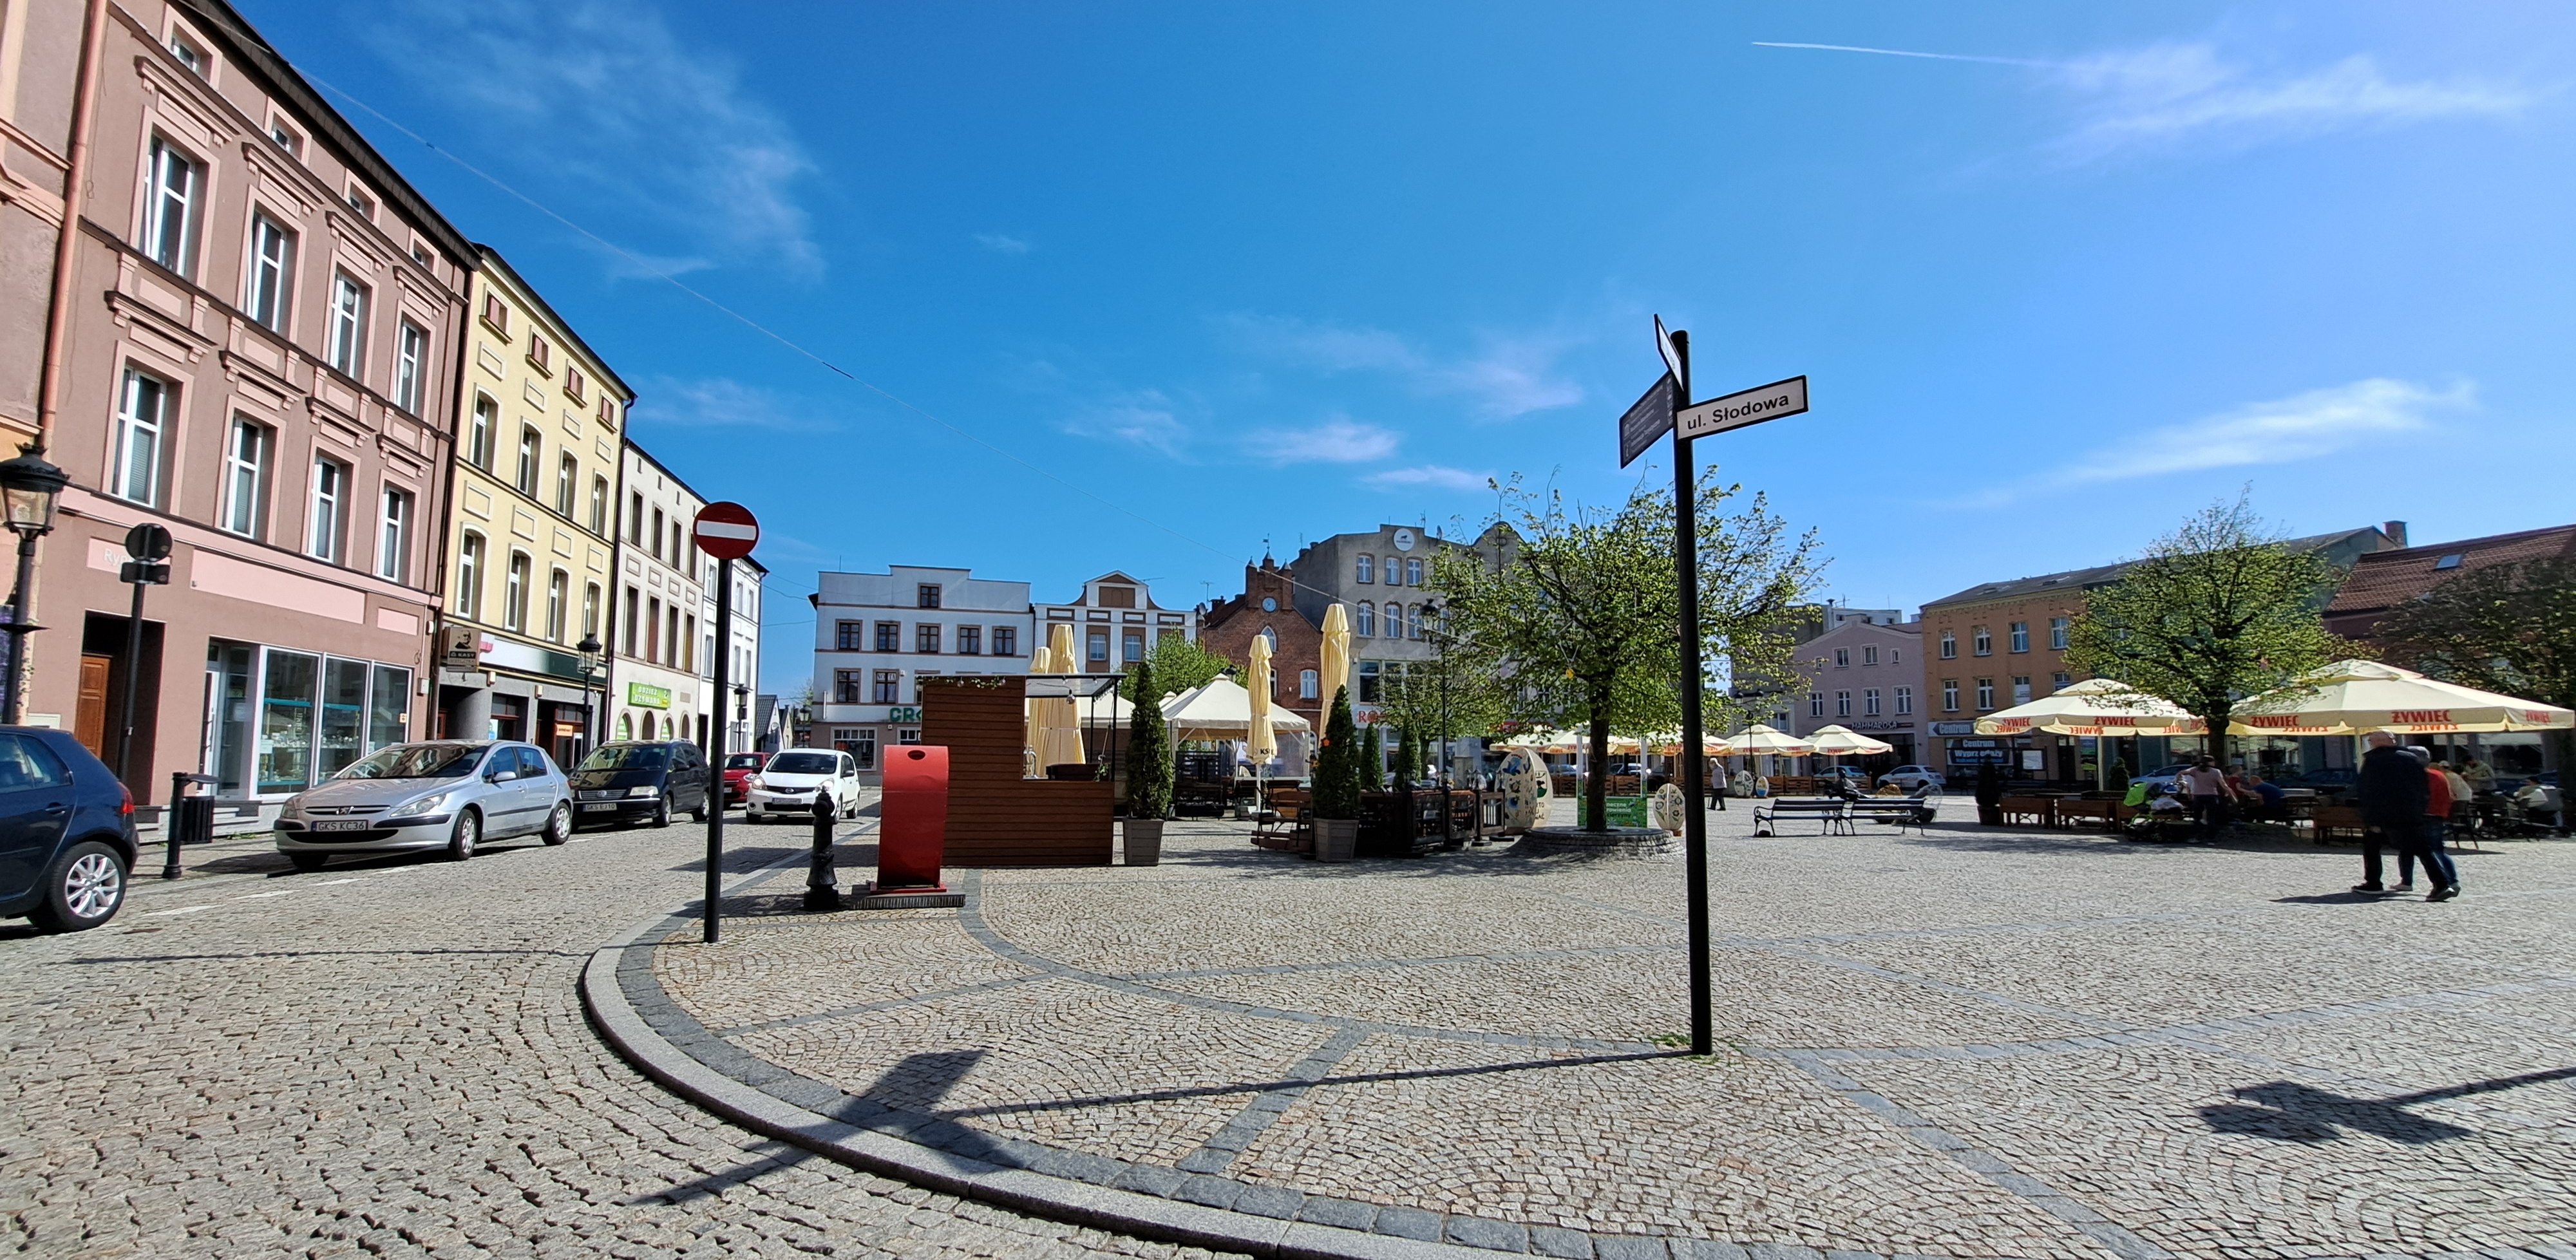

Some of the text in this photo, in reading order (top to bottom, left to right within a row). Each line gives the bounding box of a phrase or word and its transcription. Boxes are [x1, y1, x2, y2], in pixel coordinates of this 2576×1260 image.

[1687, 395, 1789, 430] ul. Słodowa
[2094, 717, 2136, 726] ŻYWIEC
[2251, 715, 2300, 726] ŻYWIEC
[2392, 710, 2452, 723] ŻYWIEC
[1939, 723, 1970, 734] Centrum
[318, 821, 364, 831] GKS KC36
